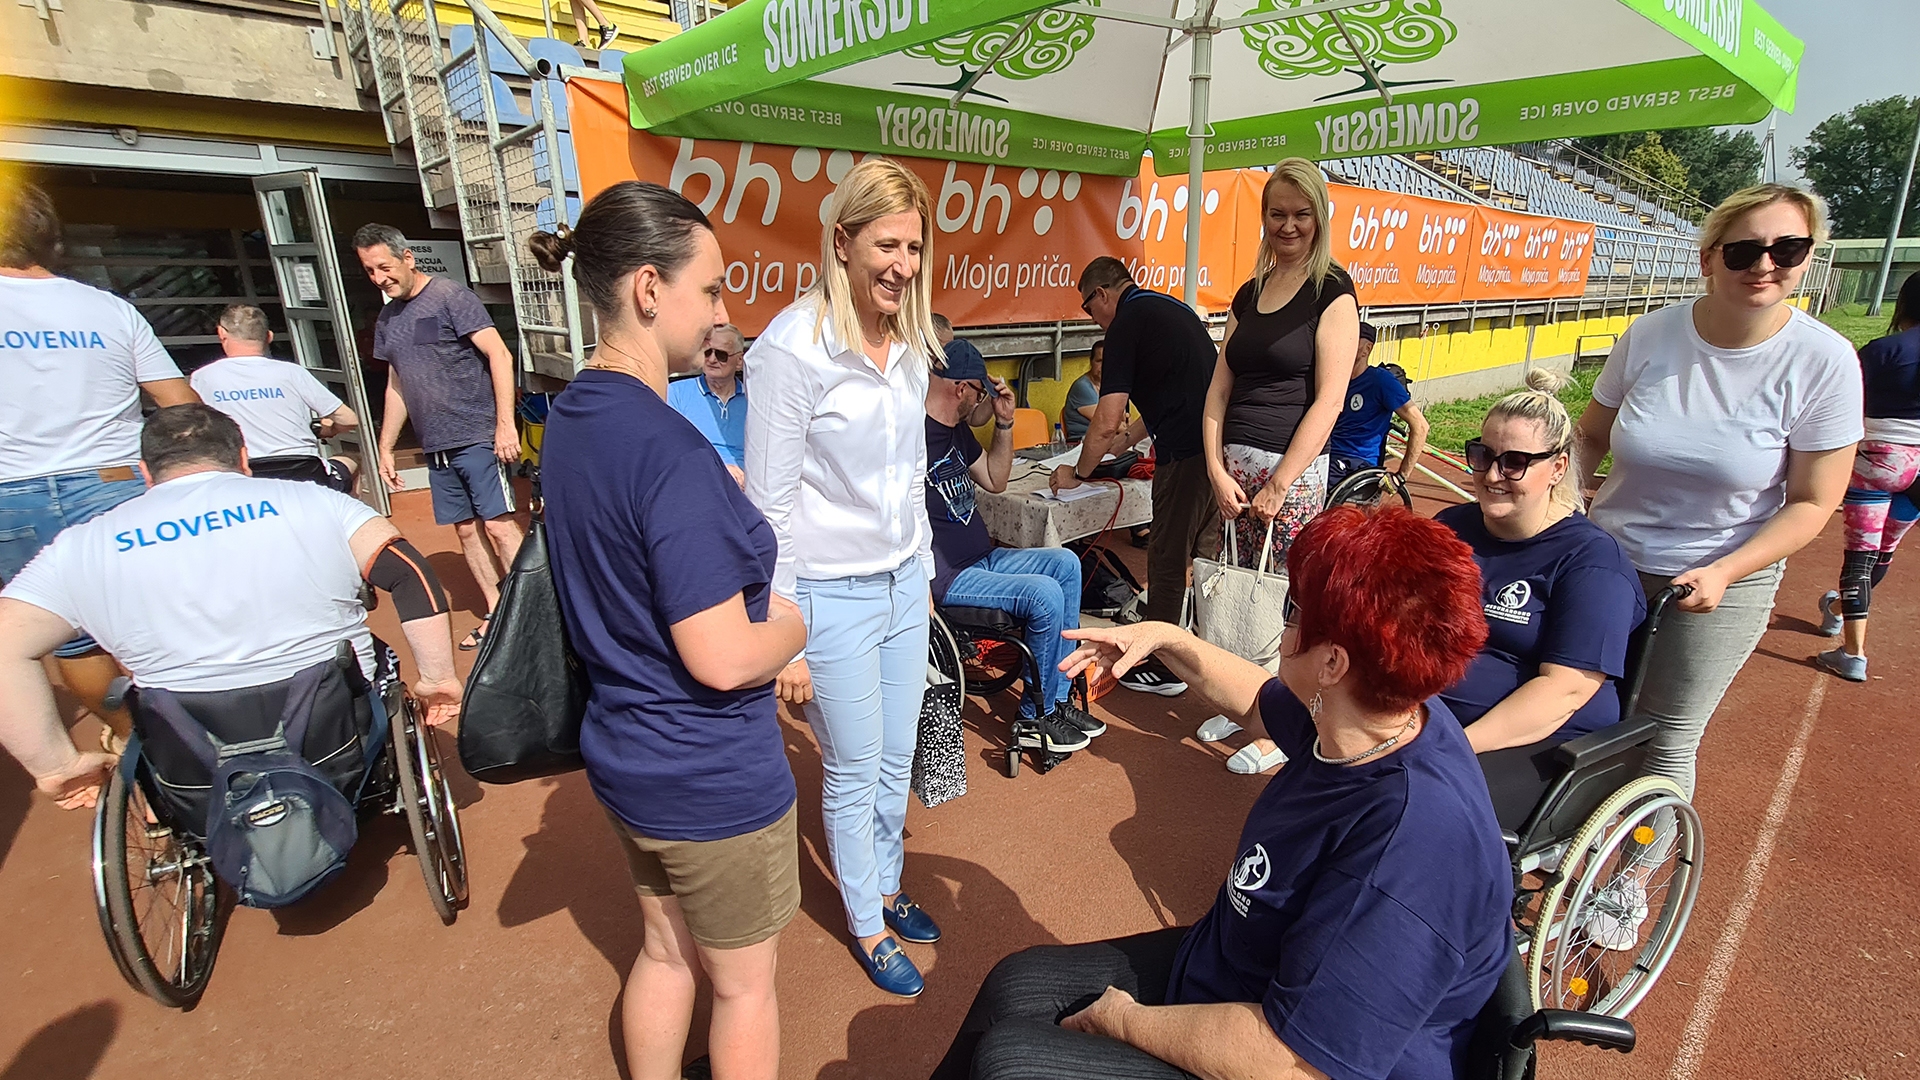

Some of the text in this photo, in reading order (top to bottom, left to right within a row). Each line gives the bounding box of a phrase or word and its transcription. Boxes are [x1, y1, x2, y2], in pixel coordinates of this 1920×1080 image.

[642, 43, 738, 98] BEST SERVED OVER ICE
[725, 251, 784, 305] oja
[943, 254, 1076, 299] Moja priča.
[1347, 261, 1400, 290] Moja priča.
[1415, 263, 1438, 290] Moja
[213, 387, 286, 403] SLOVENIA
[115, 500, 279, 552] SLOVENIA
